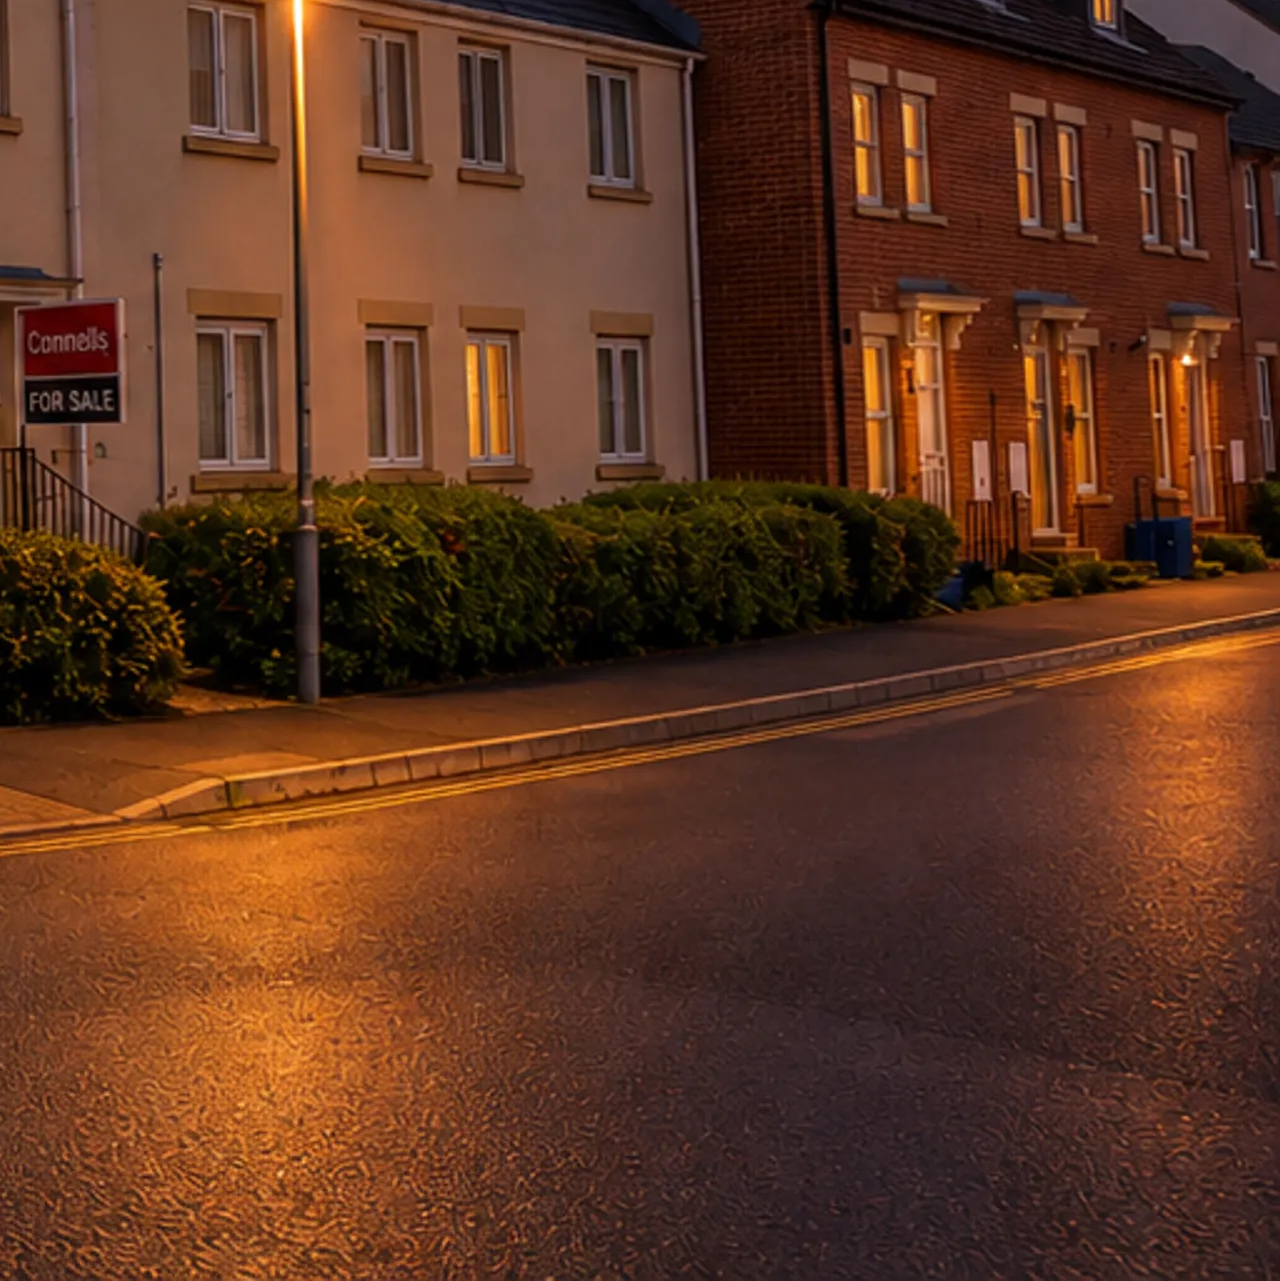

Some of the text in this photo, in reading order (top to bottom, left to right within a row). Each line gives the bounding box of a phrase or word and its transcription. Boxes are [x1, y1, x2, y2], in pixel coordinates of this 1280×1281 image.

[27, 327, 109, 354] Connells
[28, 389, 115, 412] FOR SALE
